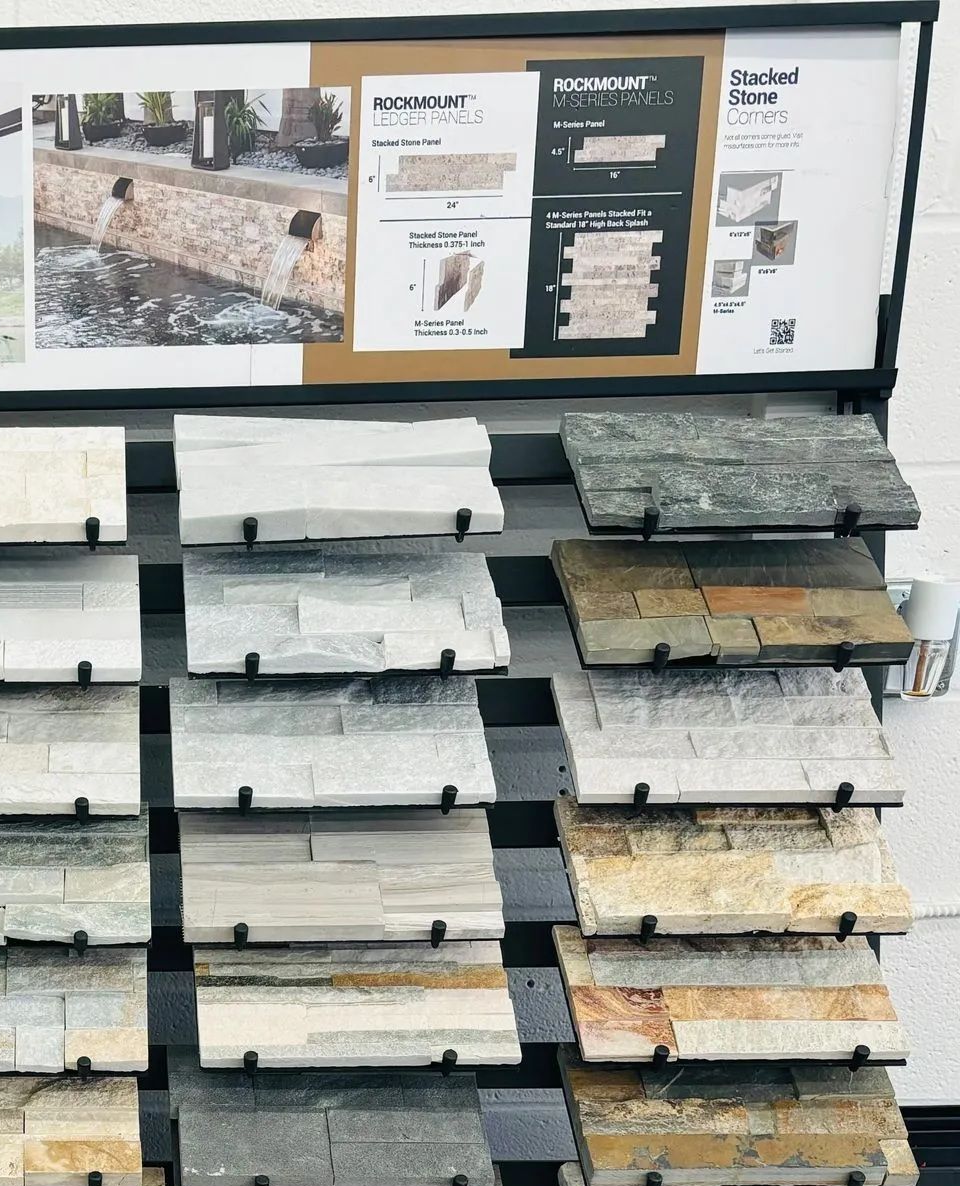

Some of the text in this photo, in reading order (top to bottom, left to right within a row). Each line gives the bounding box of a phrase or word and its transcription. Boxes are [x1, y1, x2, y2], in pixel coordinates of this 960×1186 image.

[730, 67, 799, 86] Stacked
[553, 90, 674, 108] M-SERIES PANELS
[728, 89, 778, 105] Stone
[373, 109, 484, 126] LEDGER PANELS
[727, 108, 788, 125] Corners
[553, 120, 605, 129] M-Series Panel
[372, 138, 442, 147] Stacked Stone Panel
[546, 211, 551, 219] 4
[552, 211, 583, 219] M-Series
[583, 210, 607, 218] Panels
[608, 210, 636, 218] Stacked
[636, 209, 646, 217] Fit
[545, 221, 576, 229] Standard
[590, 219, 606, 229] High
[607, 219, 624, 227] Back
[625, 219, 649, 228] Splash
[437, 231, 457, 239] Stone
[458, 230, 478, 238] Panel
[409, 240, 485, 249] Thickness 0.375-1 Inch
[414, 329, 447, 337] Thickness
[449, 328, 472, 336] 0.3-0.5
